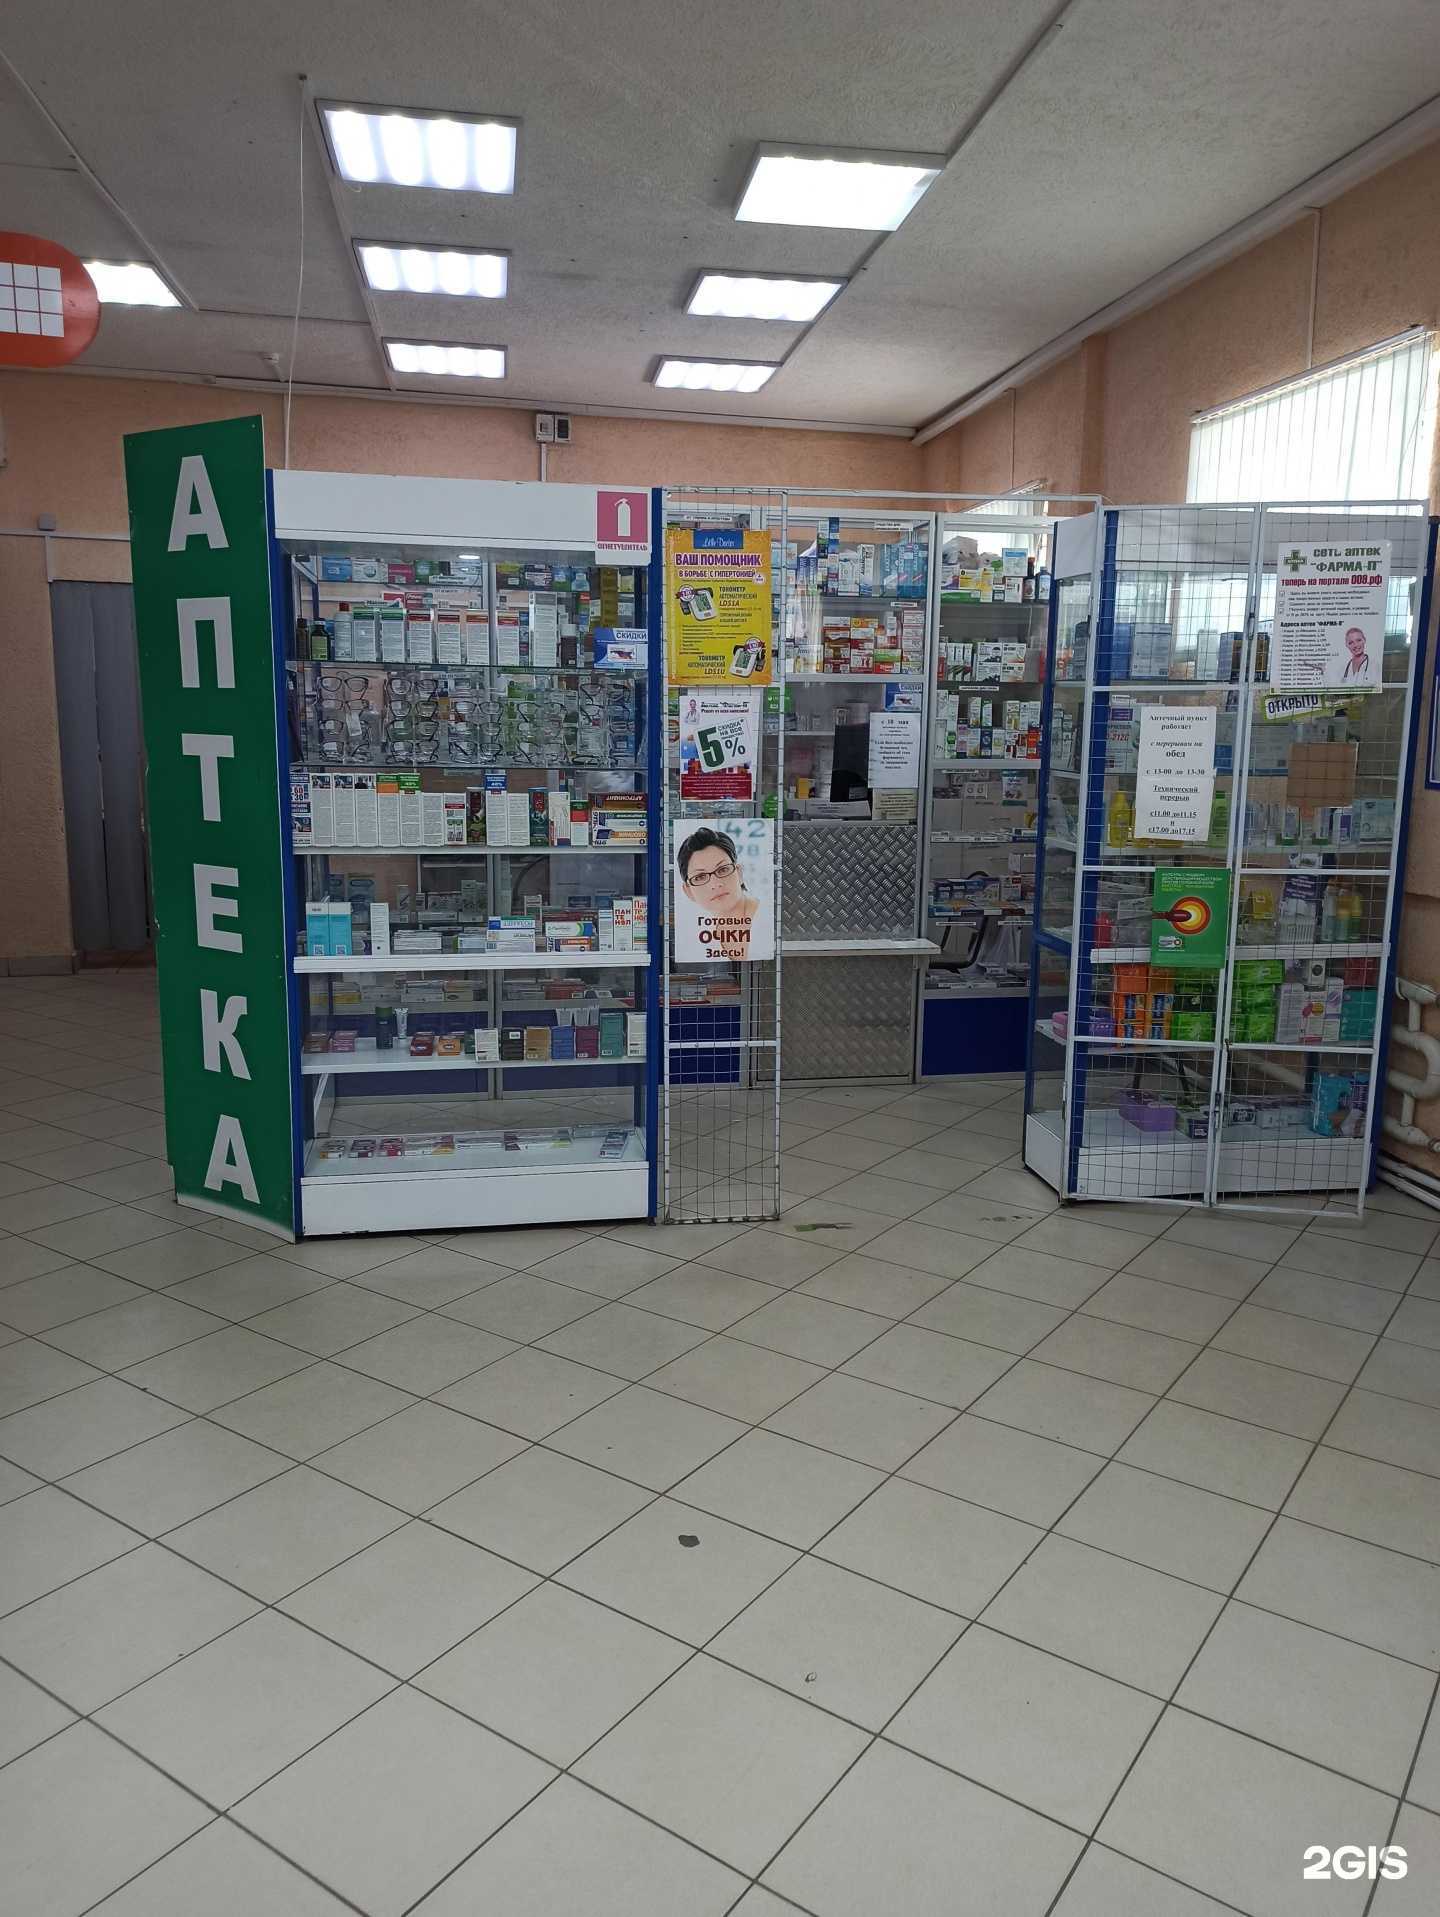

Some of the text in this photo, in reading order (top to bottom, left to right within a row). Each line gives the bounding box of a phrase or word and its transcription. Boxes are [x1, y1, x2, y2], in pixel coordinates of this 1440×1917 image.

[597, 543, 648, 551] ОГНЕТУШИТЕЛЬ
[1344, 547, 1380, 556] аптек
[675, 554, 761, 567] ВАШ ПОМОЩНИК
[684, 570, 707, 578] БОРЬБЕ
[714, 570, 756, 578] ГИПЕРТОНИЕЙ
[616, 632, 647, 640] СКИДКИ
[1268, 695, 1319, 714] ОТКРЫТО
[1166, 750, 1186, 758] обед
[168, 454, 260, 1205] АПТЕКА
[697, 917, 752, 926] Готовые
[706, 948, 744, 958] Здесь!
